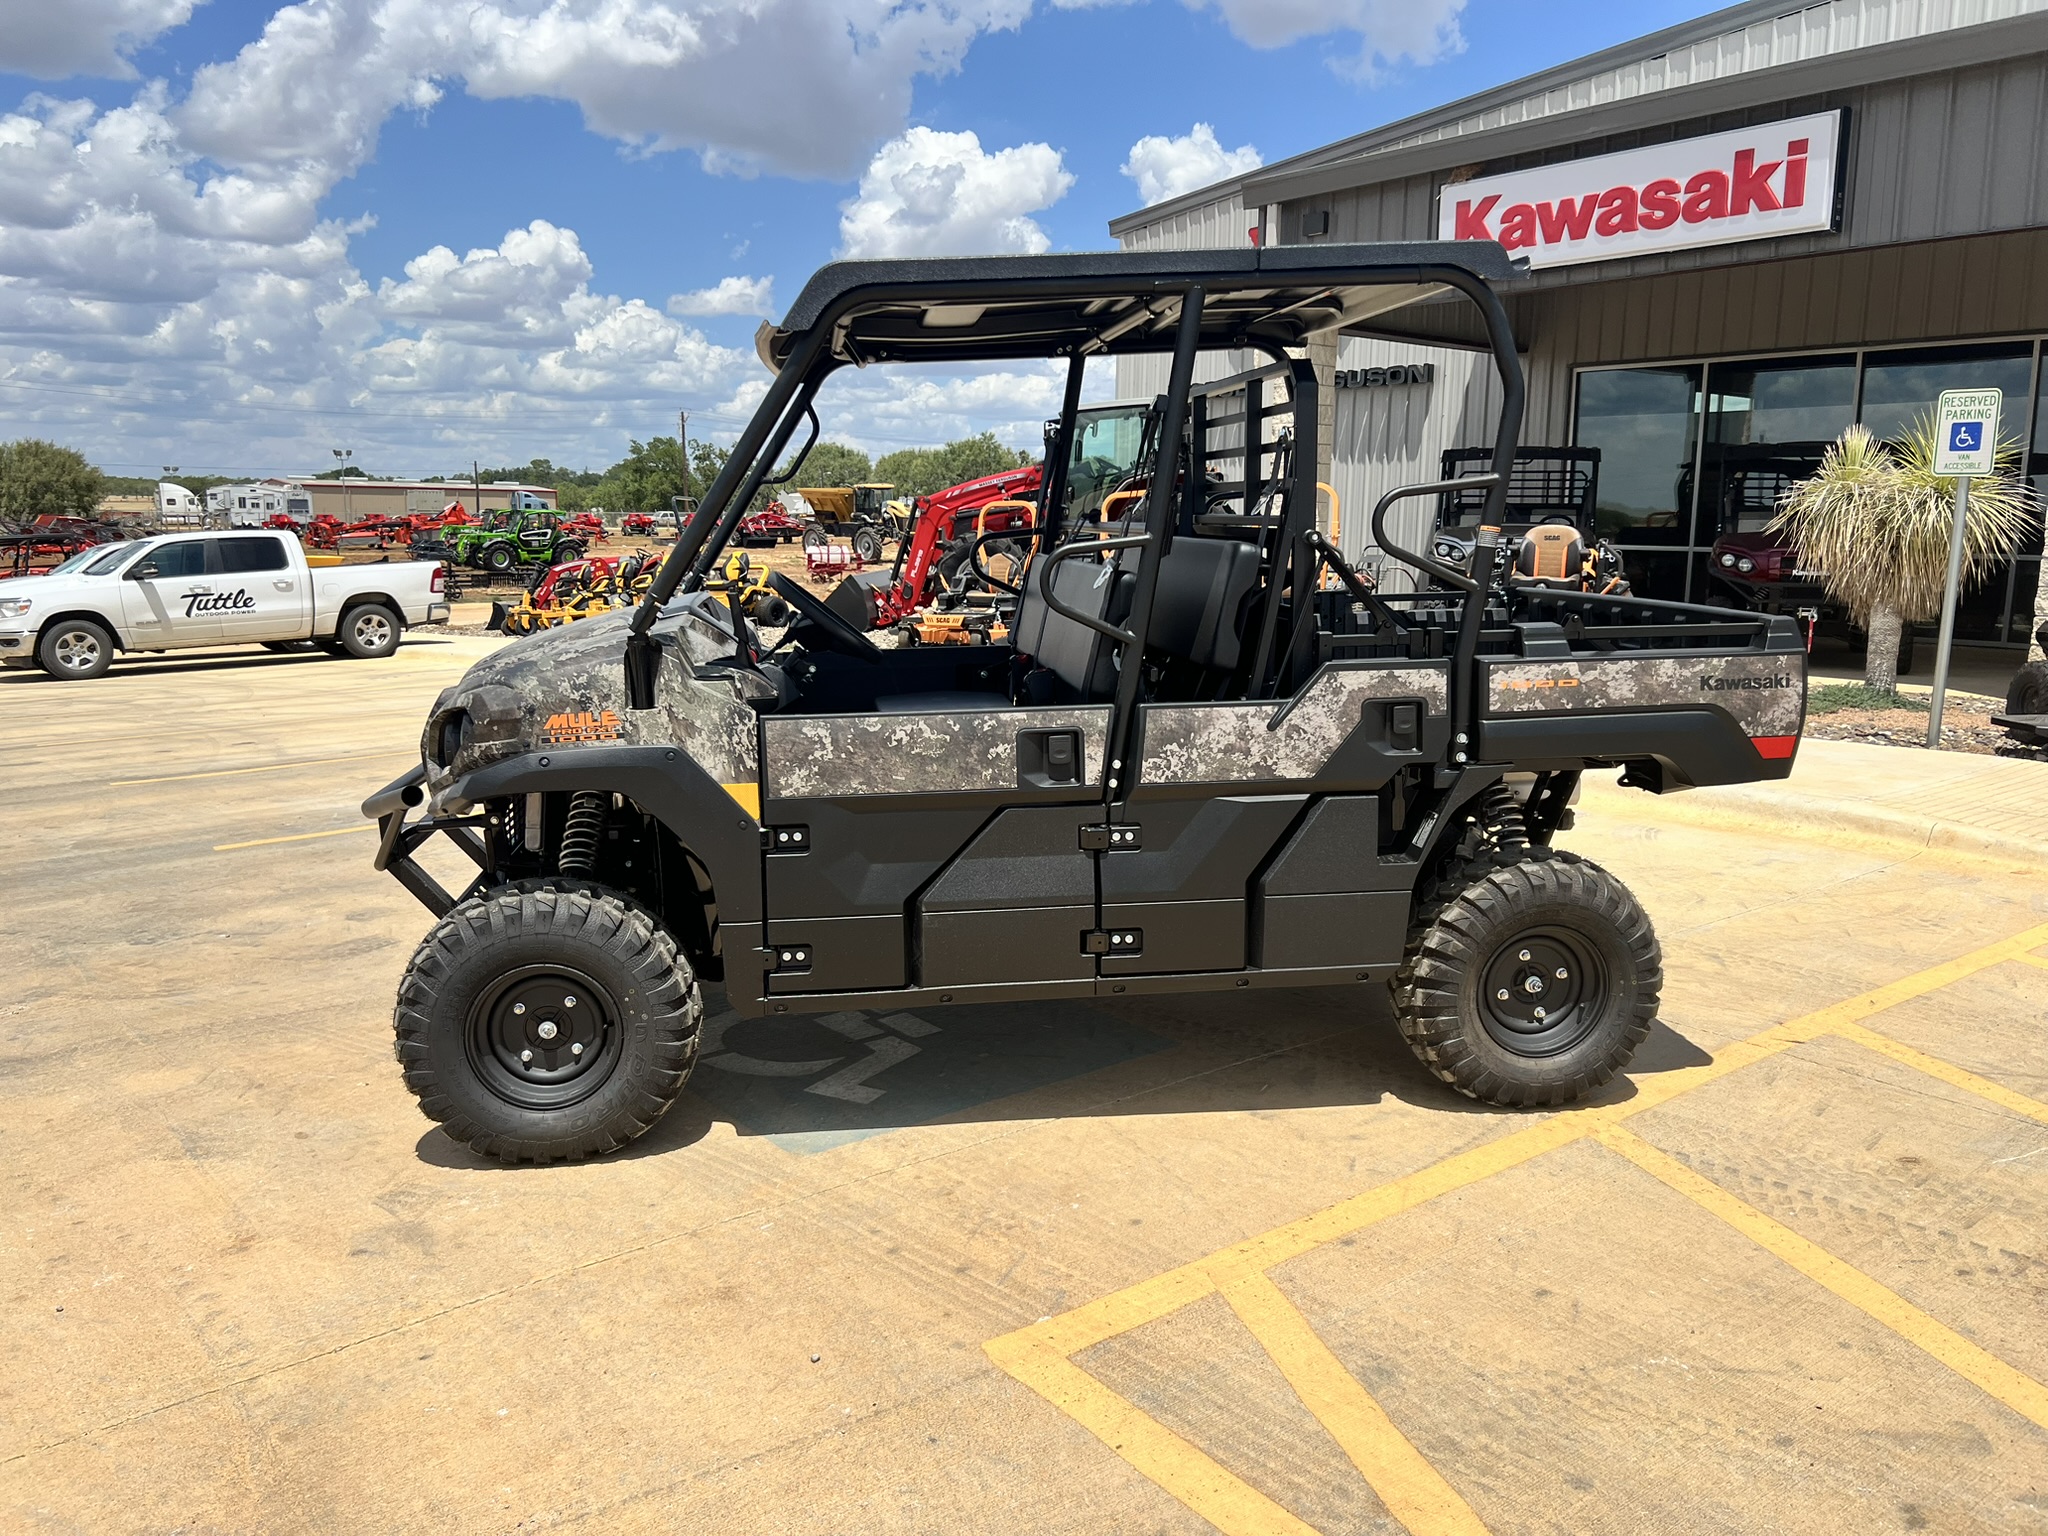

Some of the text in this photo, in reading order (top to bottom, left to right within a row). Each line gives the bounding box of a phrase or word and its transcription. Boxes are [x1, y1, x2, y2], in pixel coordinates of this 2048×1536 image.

[1454, 138, 1810, 252] Kawasaki
[1944, 396, 1996, 408] RESERVED
[1946, 409, 1992, 420] PARKING
[1944, 462, 1981, 470] ACCESSIBLE
[180, 588, 256, 618] Tuttle
[1700, 672, 1791, 692] Kawasaki
[543, 710, 621, 729] MULE
[550, 726, 615, 736] PRO FXT
[550, 732, 618, 743] 1000
